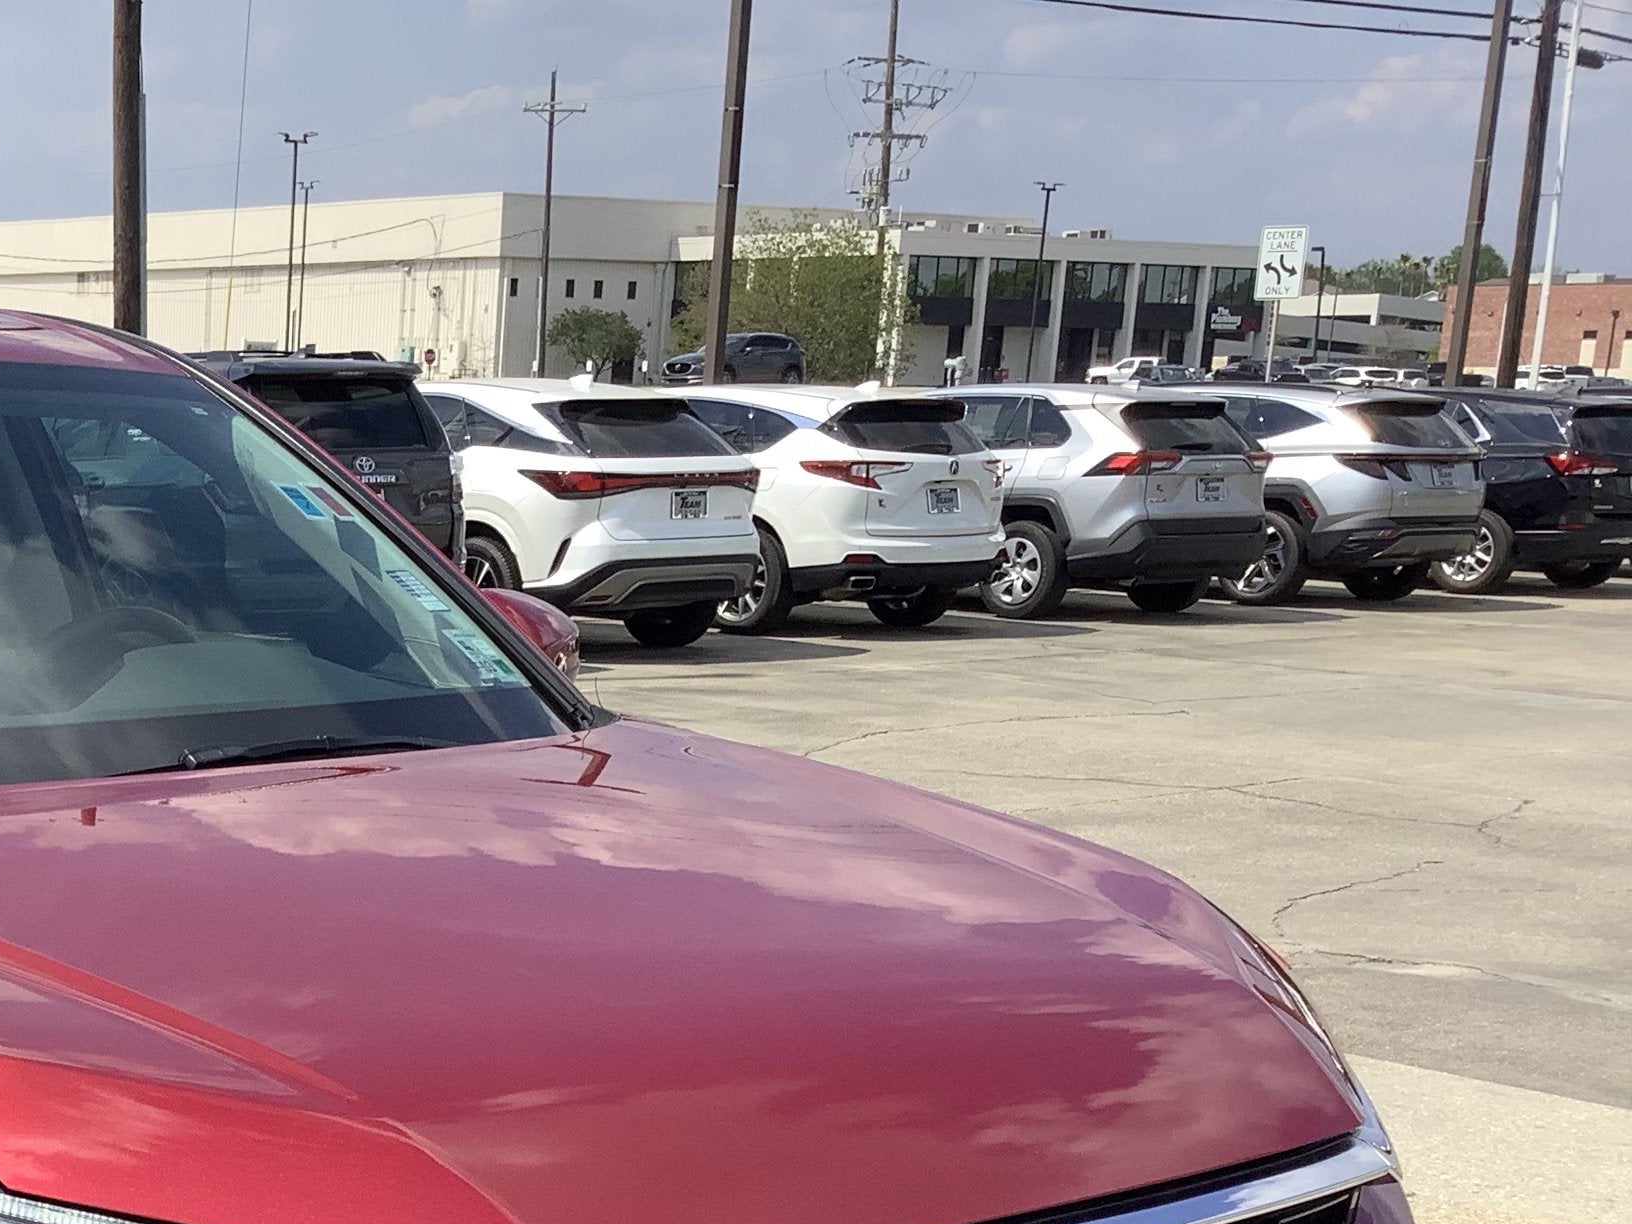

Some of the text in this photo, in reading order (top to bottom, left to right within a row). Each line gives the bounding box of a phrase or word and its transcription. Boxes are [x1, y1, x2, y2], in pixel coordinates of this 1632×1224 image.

[1266, 230, 1304, 240] CENTER
[1270, 240, 1296, 250] LANE
[1264, 286, 1291, 296] ONLY
[679, 496, 701, 509] TEAM
